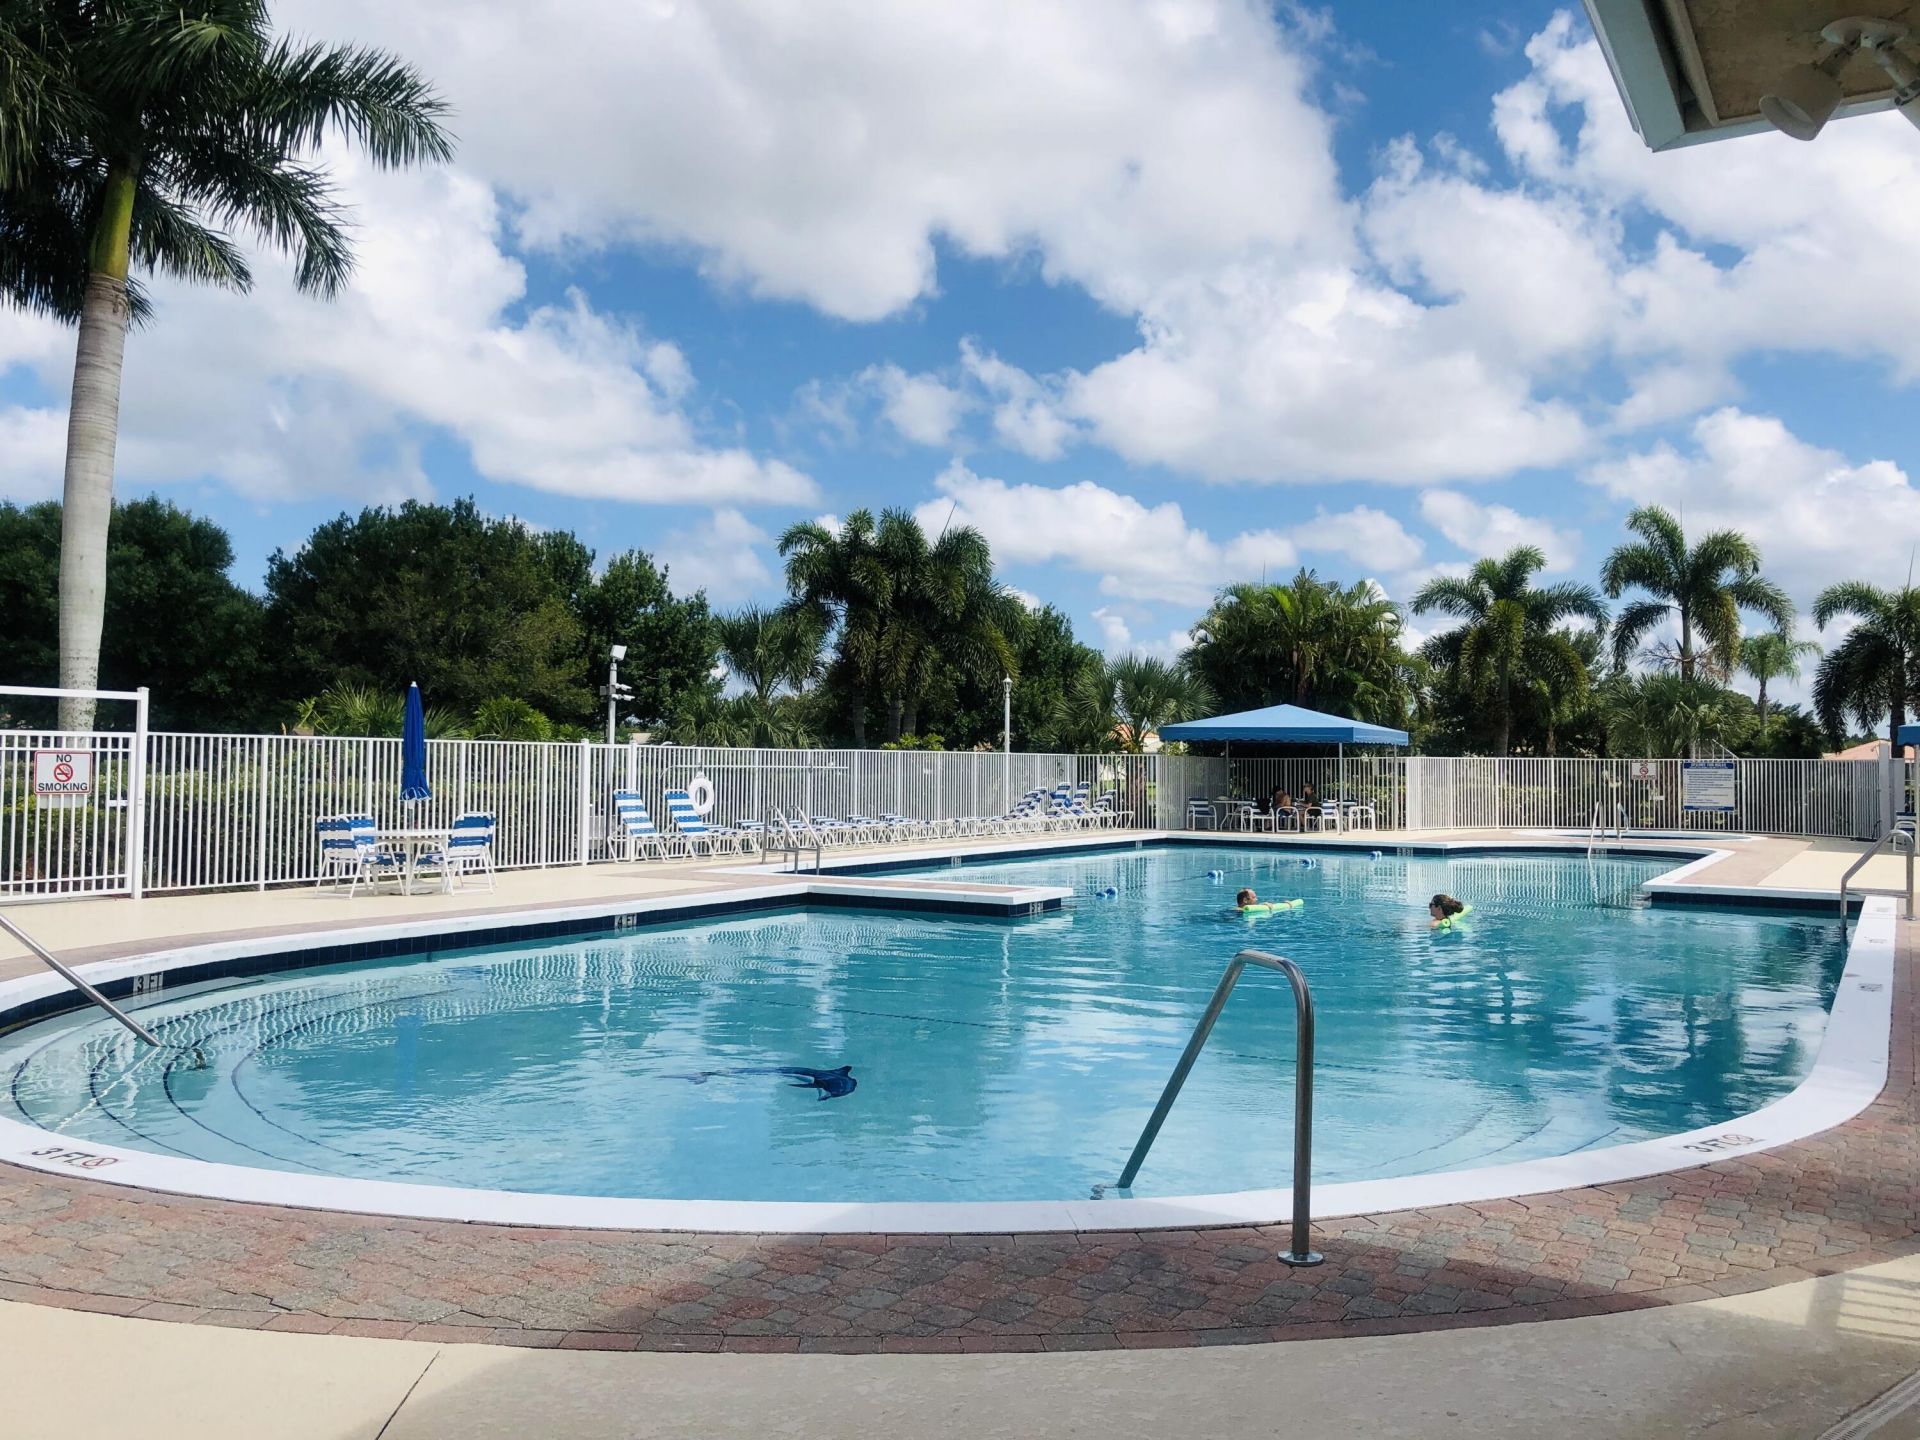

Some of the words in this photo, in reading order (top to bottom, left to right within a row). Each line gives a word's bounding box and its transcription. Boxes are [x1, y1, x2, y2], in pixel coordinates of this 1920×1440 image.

[56, 754, 72, 762] NO
[38, 782, 88, 792] SMOKING
[137, 975, 144, 992] 3
[149, 972, 162, 991] FT
[31, 1147, 64, 1156] 3
[49, 1151, 97, 1164] FT
